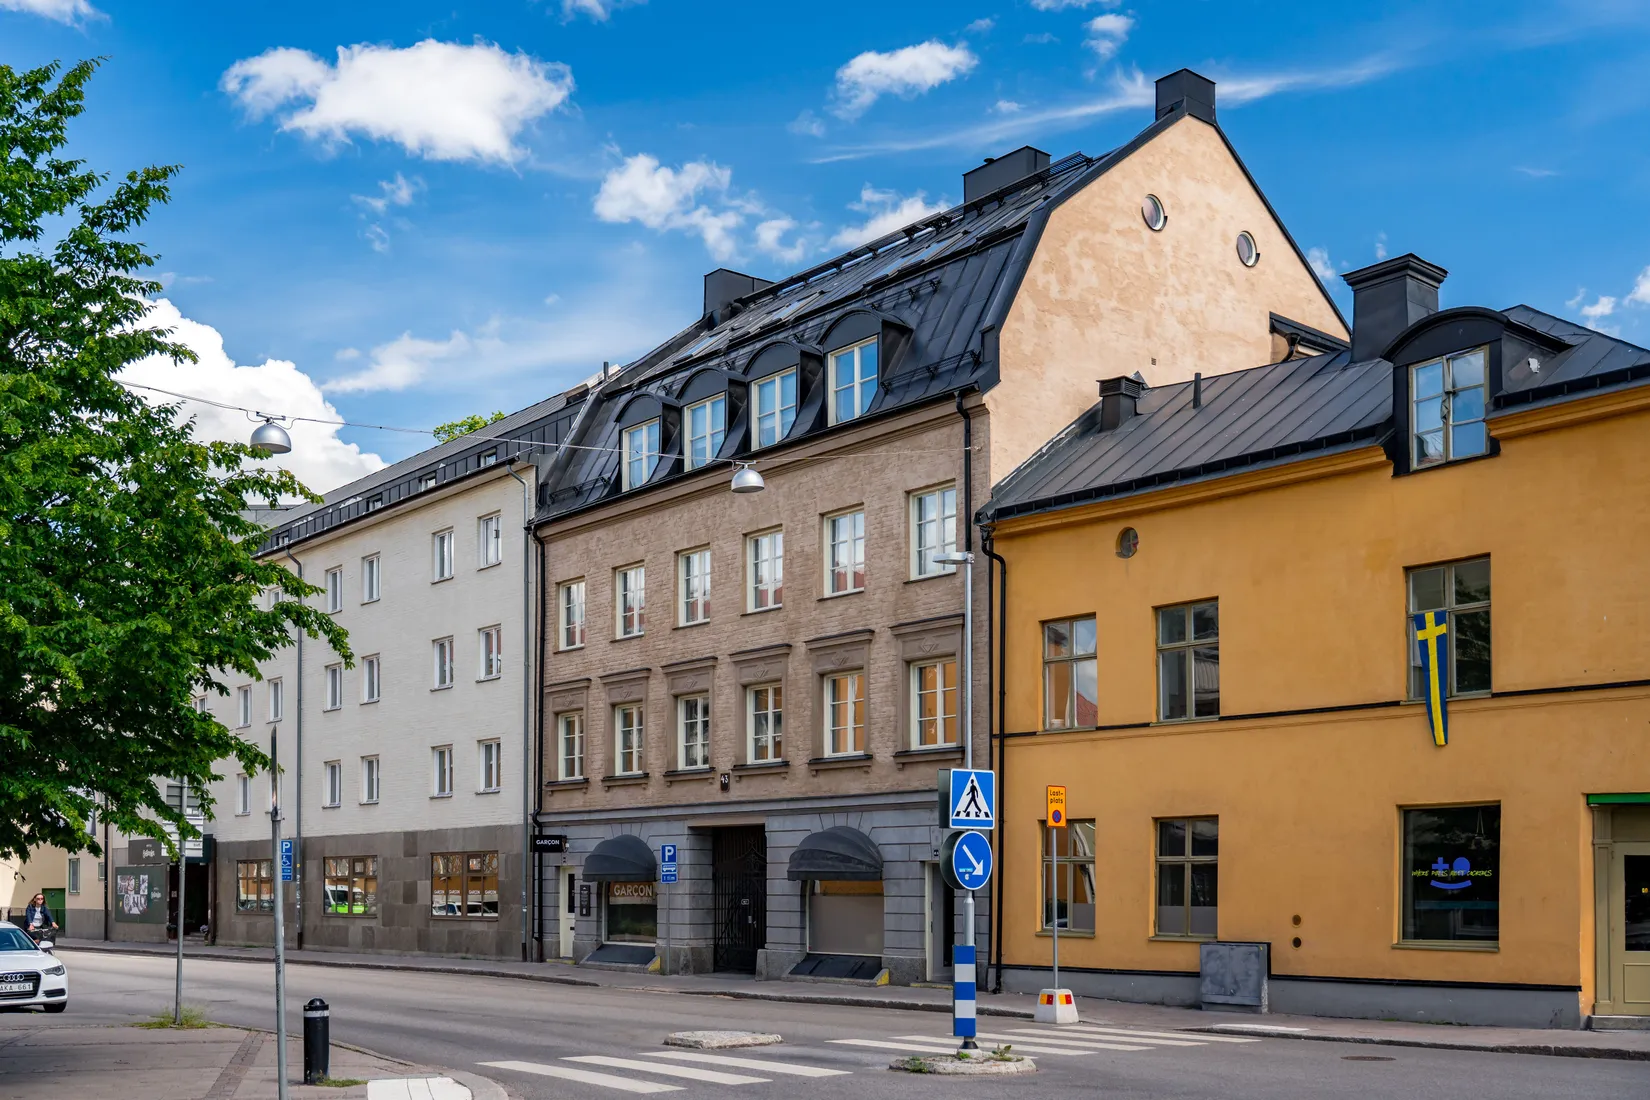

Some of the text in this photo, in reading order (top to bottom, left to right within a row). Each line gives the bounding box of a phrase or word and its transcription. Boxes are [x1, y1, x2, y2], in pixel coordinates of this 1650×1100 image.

[721, 775, 728, 783] 43
[283, 841, 291, 853] P
[664, 846, 674, 862] P
[614, 885, 653, 898] GARÇON
